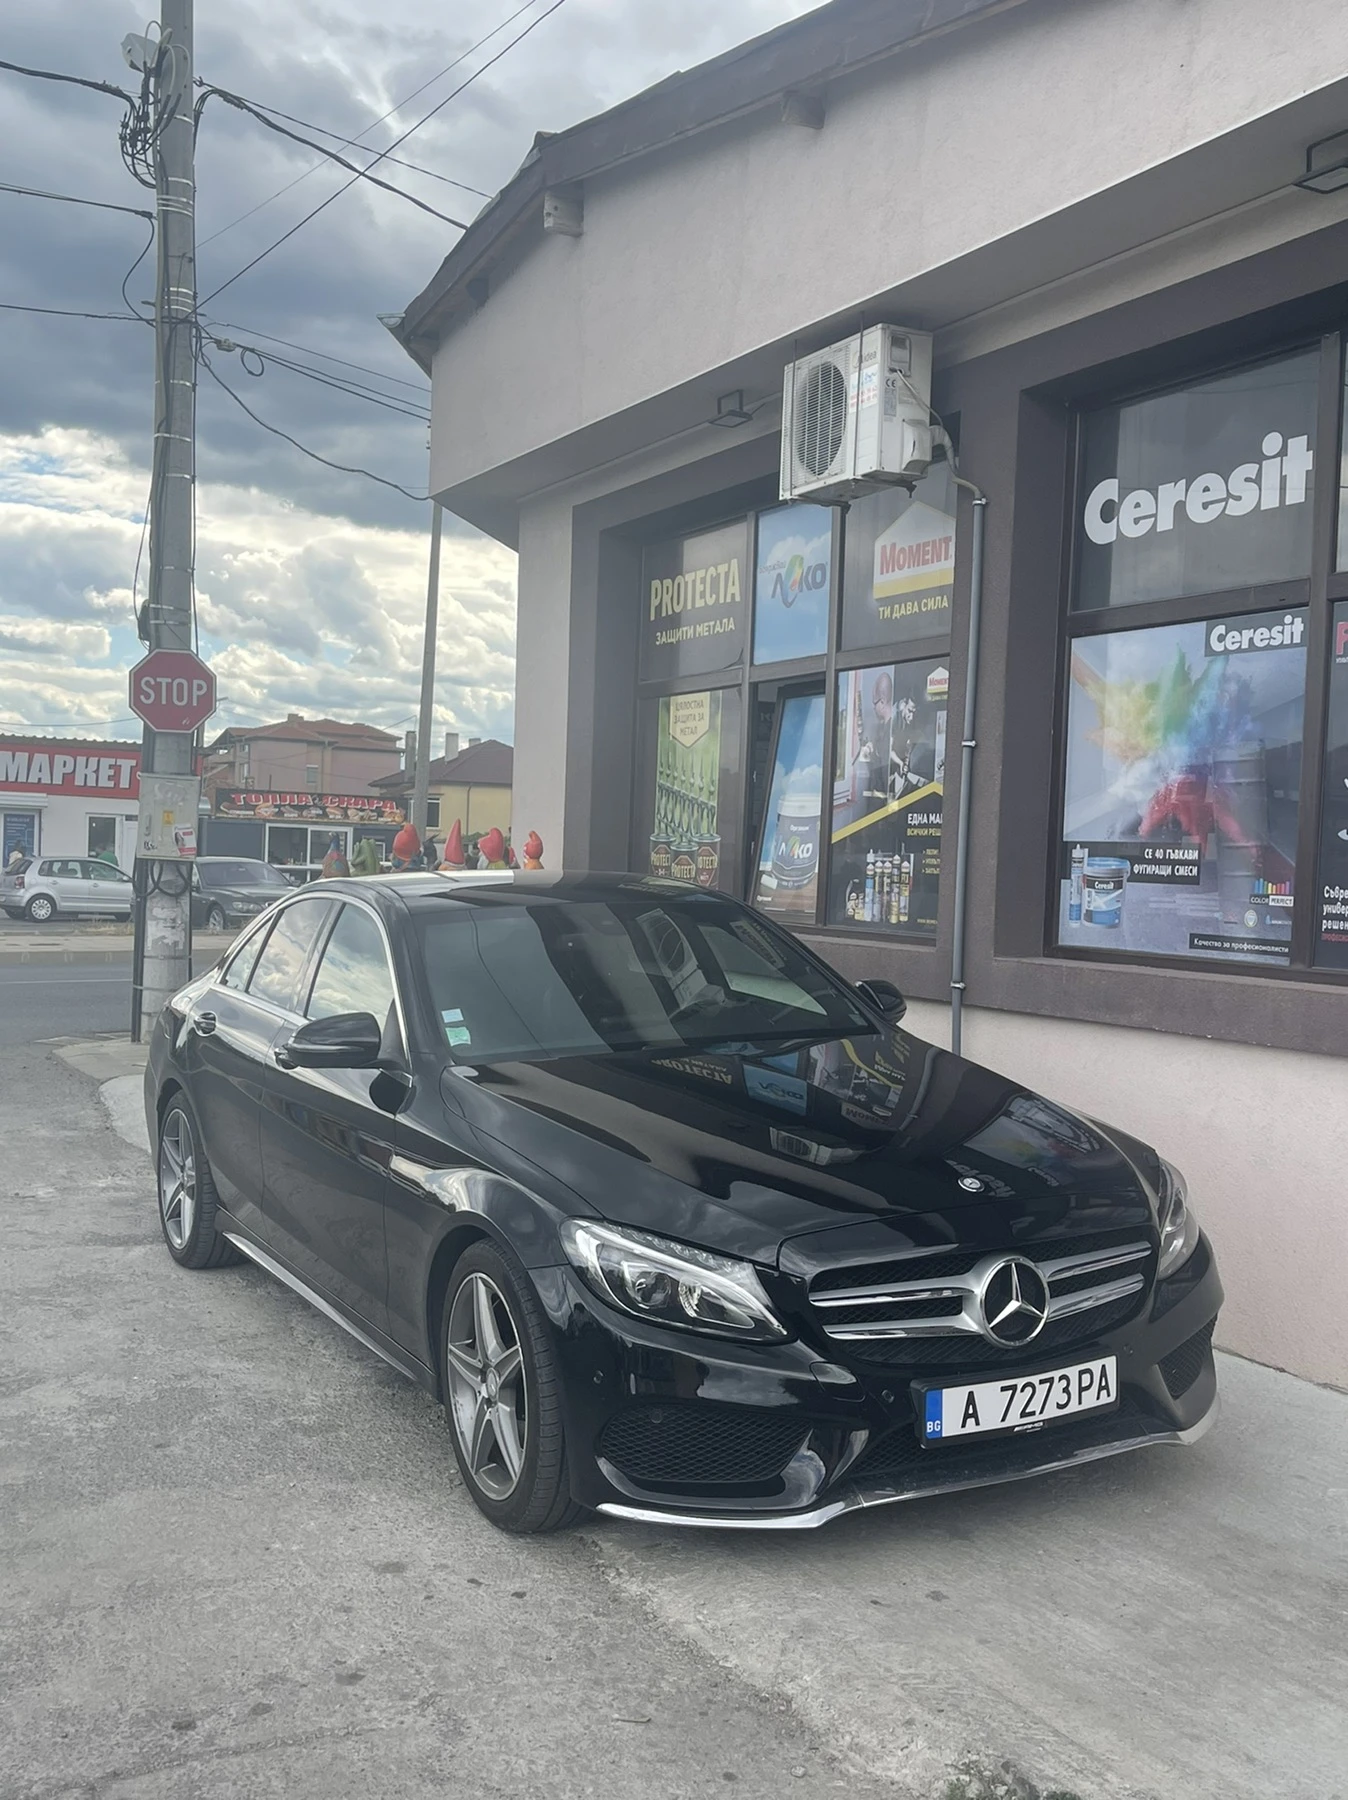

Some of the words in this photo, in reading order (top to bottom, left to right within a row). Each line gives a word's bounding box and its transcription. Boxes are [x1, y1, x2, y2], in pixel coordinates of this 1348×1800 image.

[1084, 431, 1313, 545] Ceresit
[650, 558, 741, 622] PROTECTA
[879, 605, 891, 620] ТИ
[892, 601, 919, 620] ДАВА
[921, 595, 948, 612] СИЛА
[655, 625, 694, 646] ЗАЩИТИ
[695, 617, 735, 638] МЕТАЛА
[1209, 614, 1304, 652] Ceresit
[140, 676, 208, 707] STOP
[0, 750, 137, 789] МАРКЕТ
[322, 795, 397, 812] СКАРА
[908, 813, 928, 826] ЕДНА
[1155, 848, 1164, 859] 40
[1166, 849, 1199, 860] ГЪВКАВИ
[1133, 863, 1172, 877] ФУГИРАЩИ
[1174, 864, 1198, 877] СМЕСИ
[1194, 937, 1222, 948] Качество
[1231, 942, 1289, 953] професионалисти
[960, 1390, 981, 1429] A
[926, 1420, 941, 1434] BG
